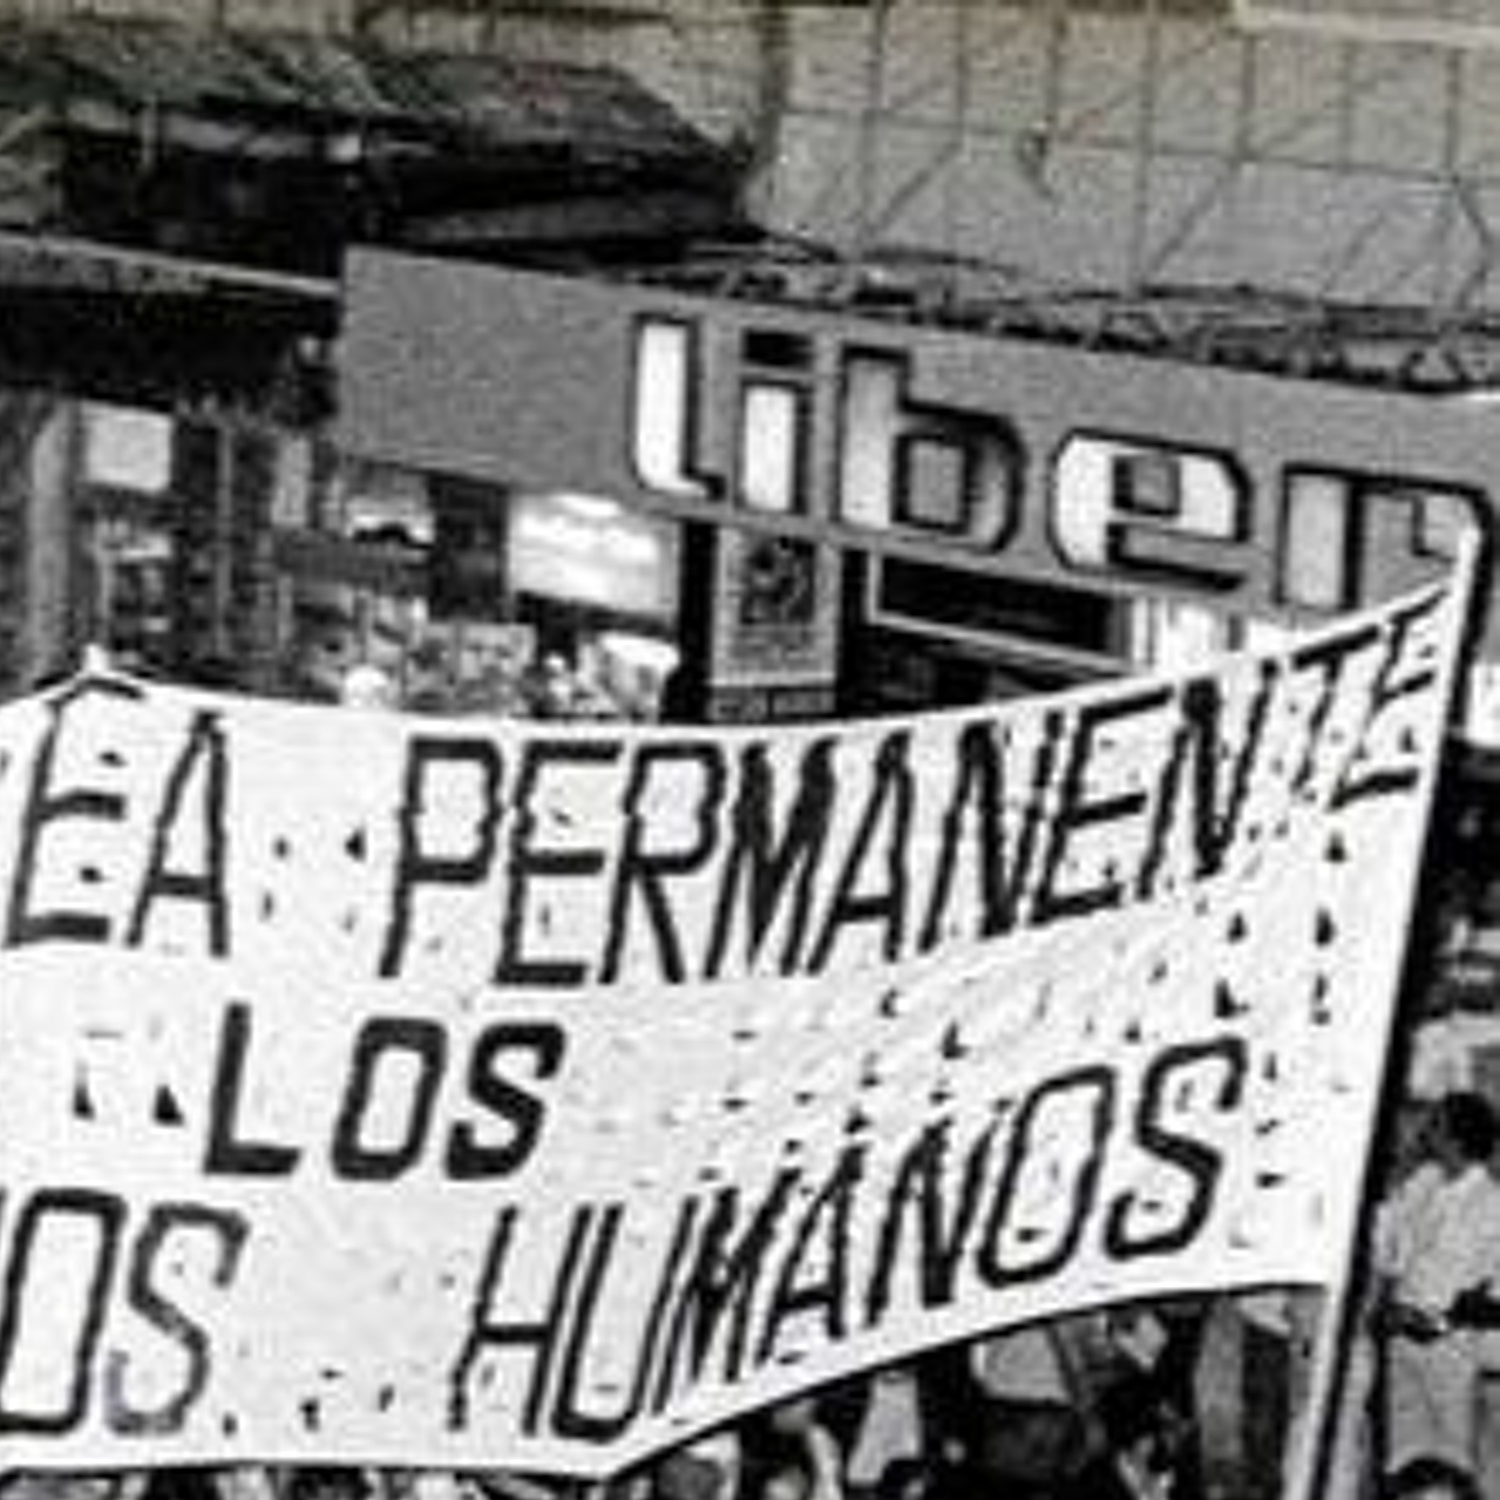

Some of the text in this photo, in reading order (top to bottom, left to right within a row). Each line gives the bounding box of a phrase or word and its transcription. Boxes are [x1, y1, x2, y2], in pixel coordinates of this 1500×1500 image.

[378, 588, 1452, 988] PERMANENTE
[202, 1002, 566, 1182] LOS
[450, 1036, 1248, 1440] HUMANOS
